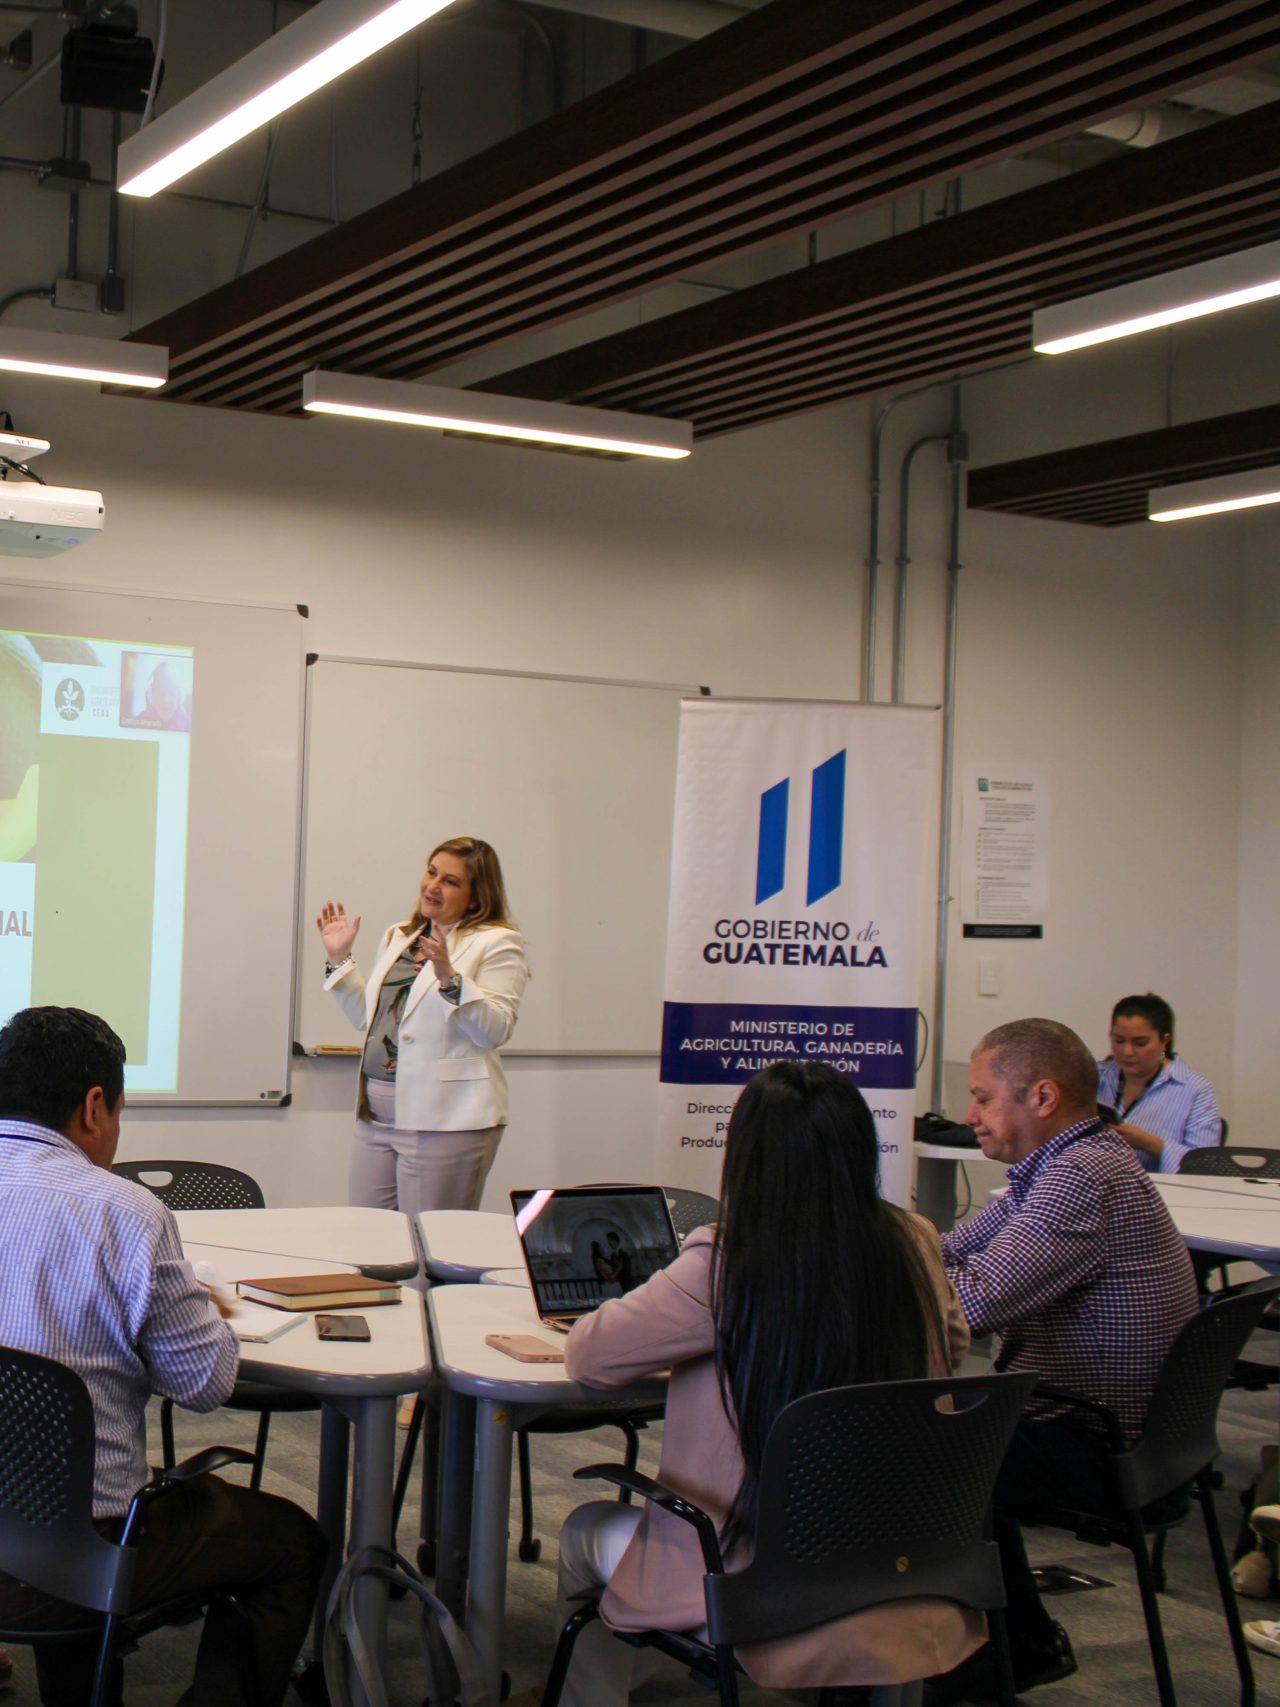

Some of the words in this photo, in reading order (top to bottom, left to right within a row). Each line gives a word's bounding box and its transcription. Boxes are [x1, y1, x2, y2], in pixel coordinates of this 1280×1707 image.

[714, 919, 850, 941] GOBIERNO
[856, 920, 880, 942] de
[703, 942, 889, 968] GUATEMALA
[730, 1020, 828, 1036] MINISTERIO
[833, 1023, 855, 1036] DE
[680, 1038, 800, 1054] AGRICULTURA,
[805, 1040, 904, 1056] GANADERÍA
[721, 1056, 732, 1070] Y
